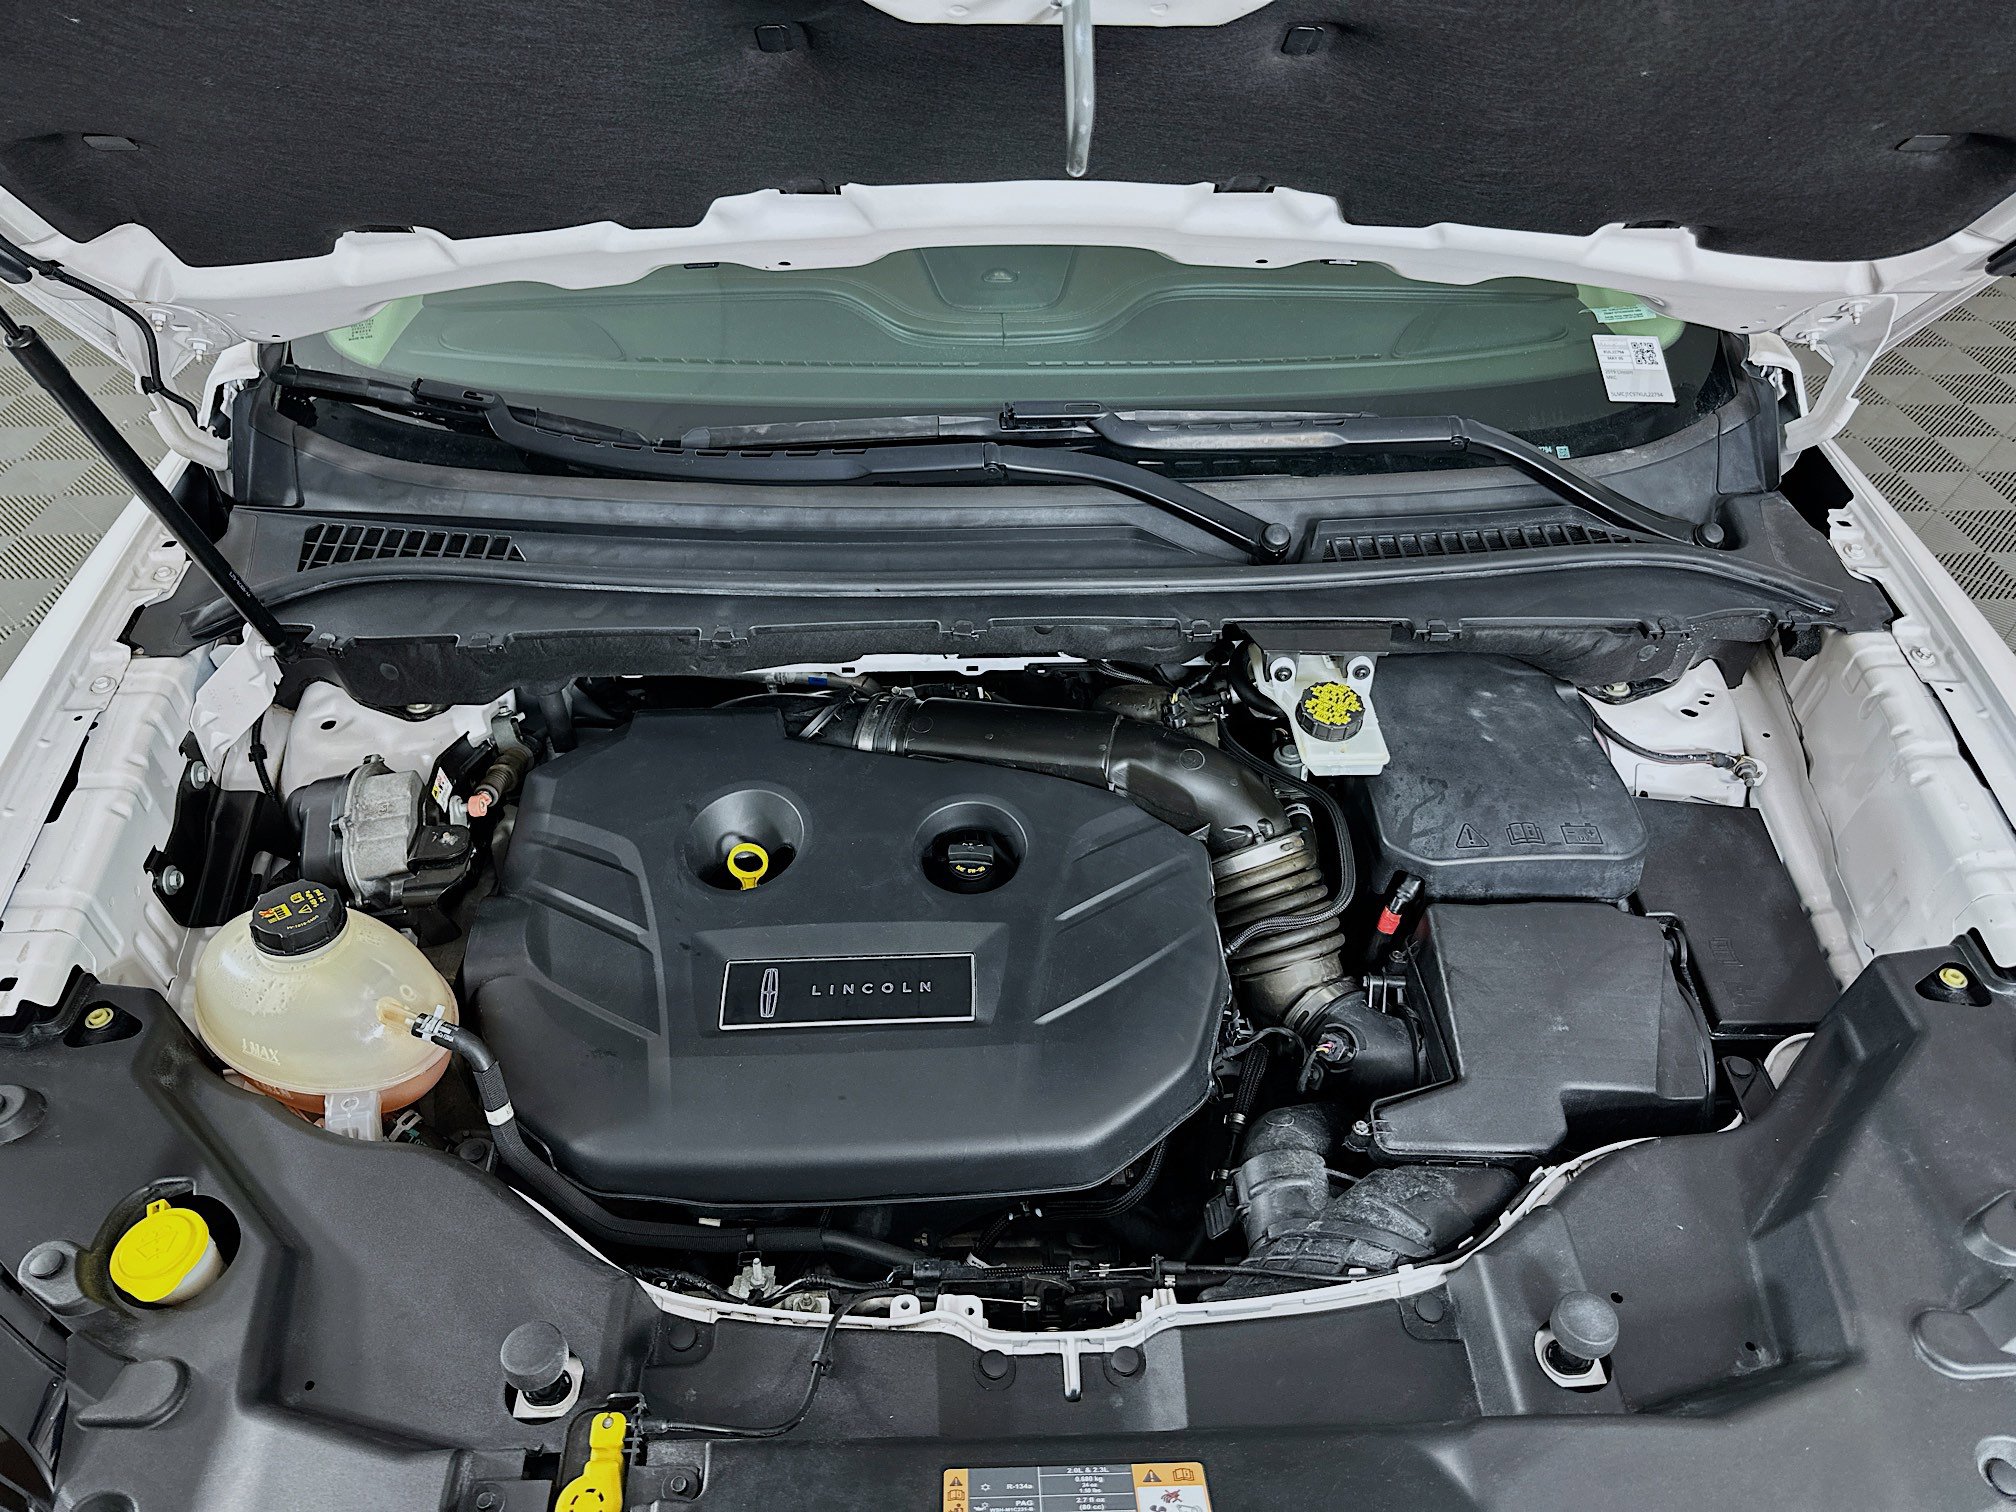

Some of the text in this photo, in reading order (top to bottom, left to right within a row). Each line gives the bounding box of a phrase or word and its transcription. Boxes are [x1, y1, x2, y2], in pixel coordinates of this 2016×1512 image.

[812, 981, 932, 996] LINCOLN
[1094, 1475, 1104, 1483] kg
[1015, 1499, 1035, 1507] PAG
